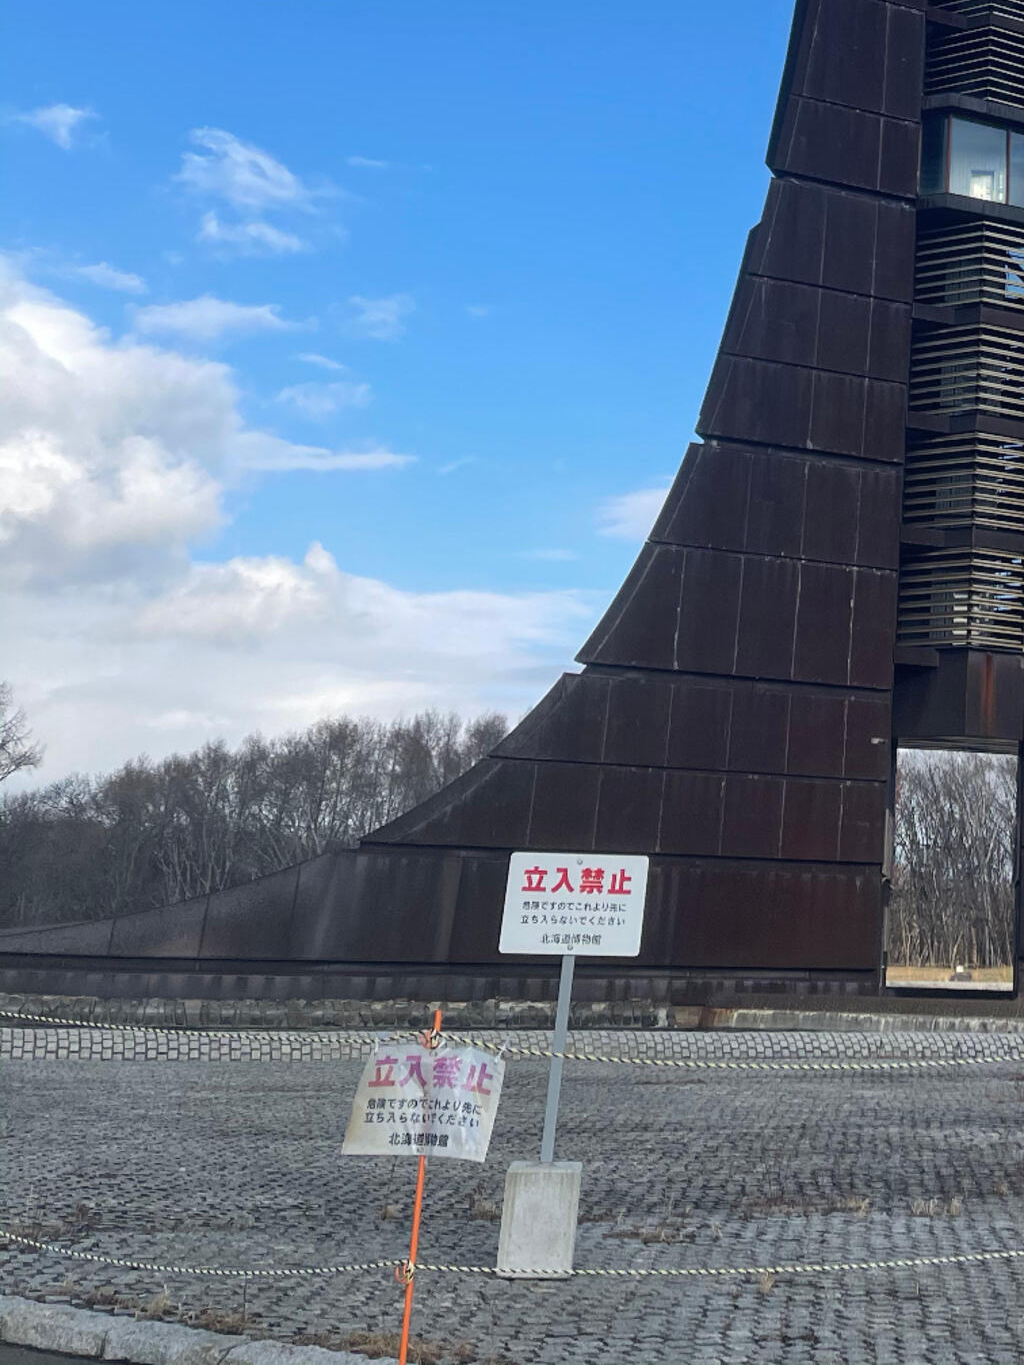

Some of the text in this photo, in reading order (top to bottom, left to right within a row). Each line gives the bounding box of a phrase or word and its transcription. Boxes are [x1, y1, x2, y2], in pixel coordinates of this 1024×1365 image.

[521, 866, 632, 895] 立入禁止
[520, 914, 625, 926] 立ち入らないでください
[540, 933, 602, 945] 北海道博物館
[368, 1055, 493, 1096] 立入禁止
